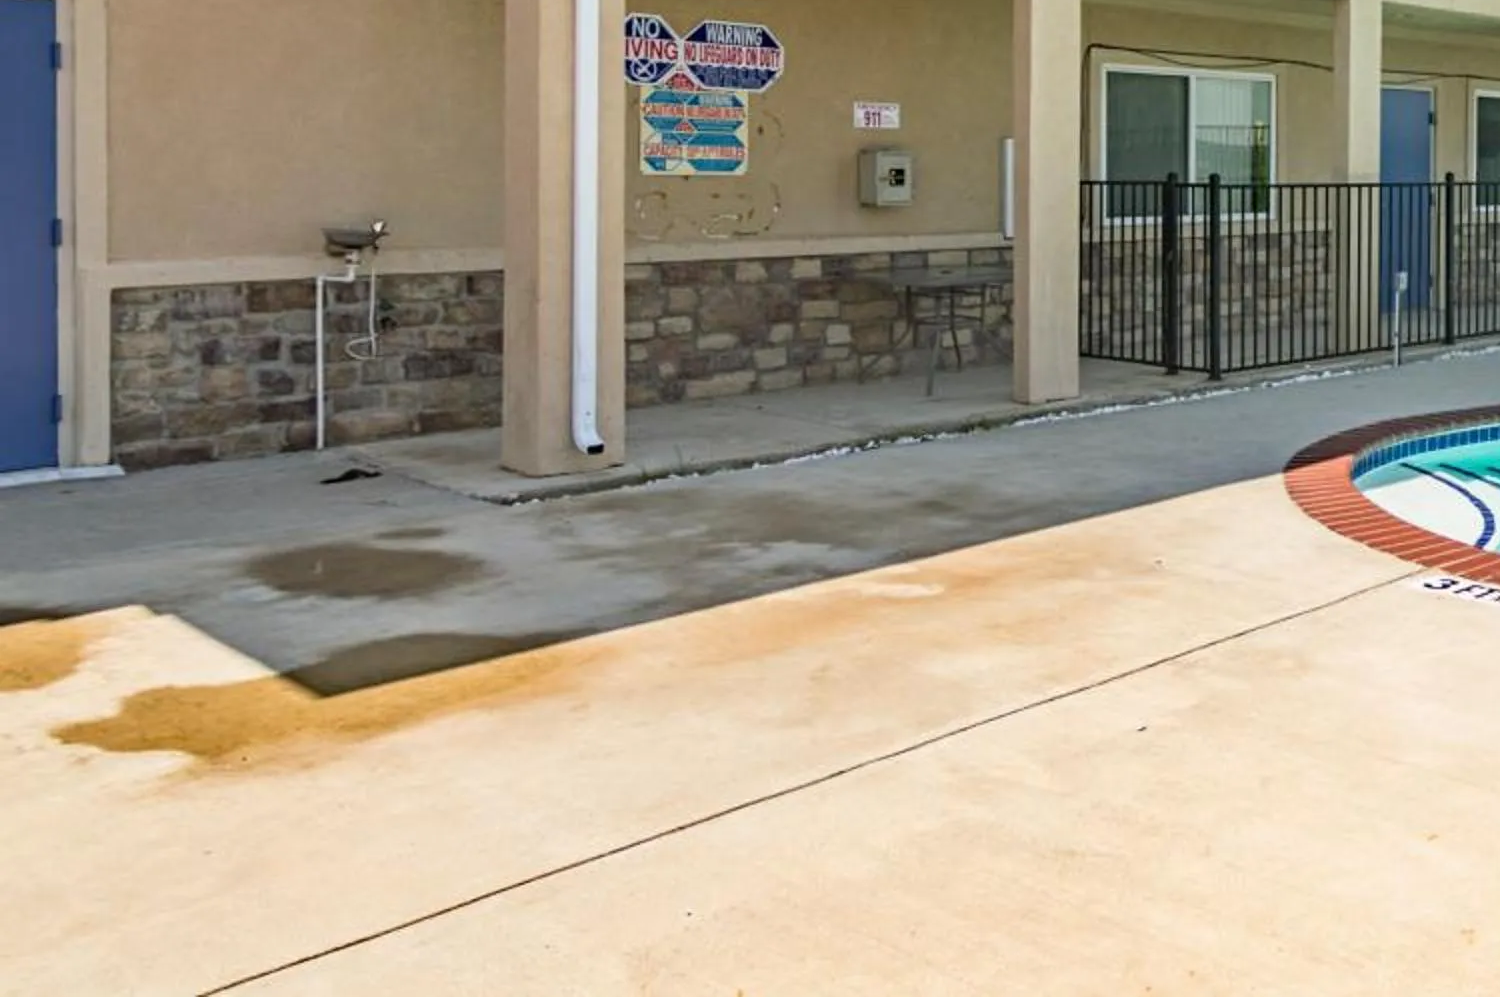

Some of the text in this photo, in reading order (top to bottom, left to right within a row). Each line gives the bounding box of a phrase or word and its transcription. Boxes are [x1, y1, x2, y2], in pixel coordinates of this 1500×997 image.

[631, 18, 660, 38] NO
[705, 23, 763, 46] WARNING
[625, 39, 679, 61] IVING
[864, 110, 881, 126] 911
